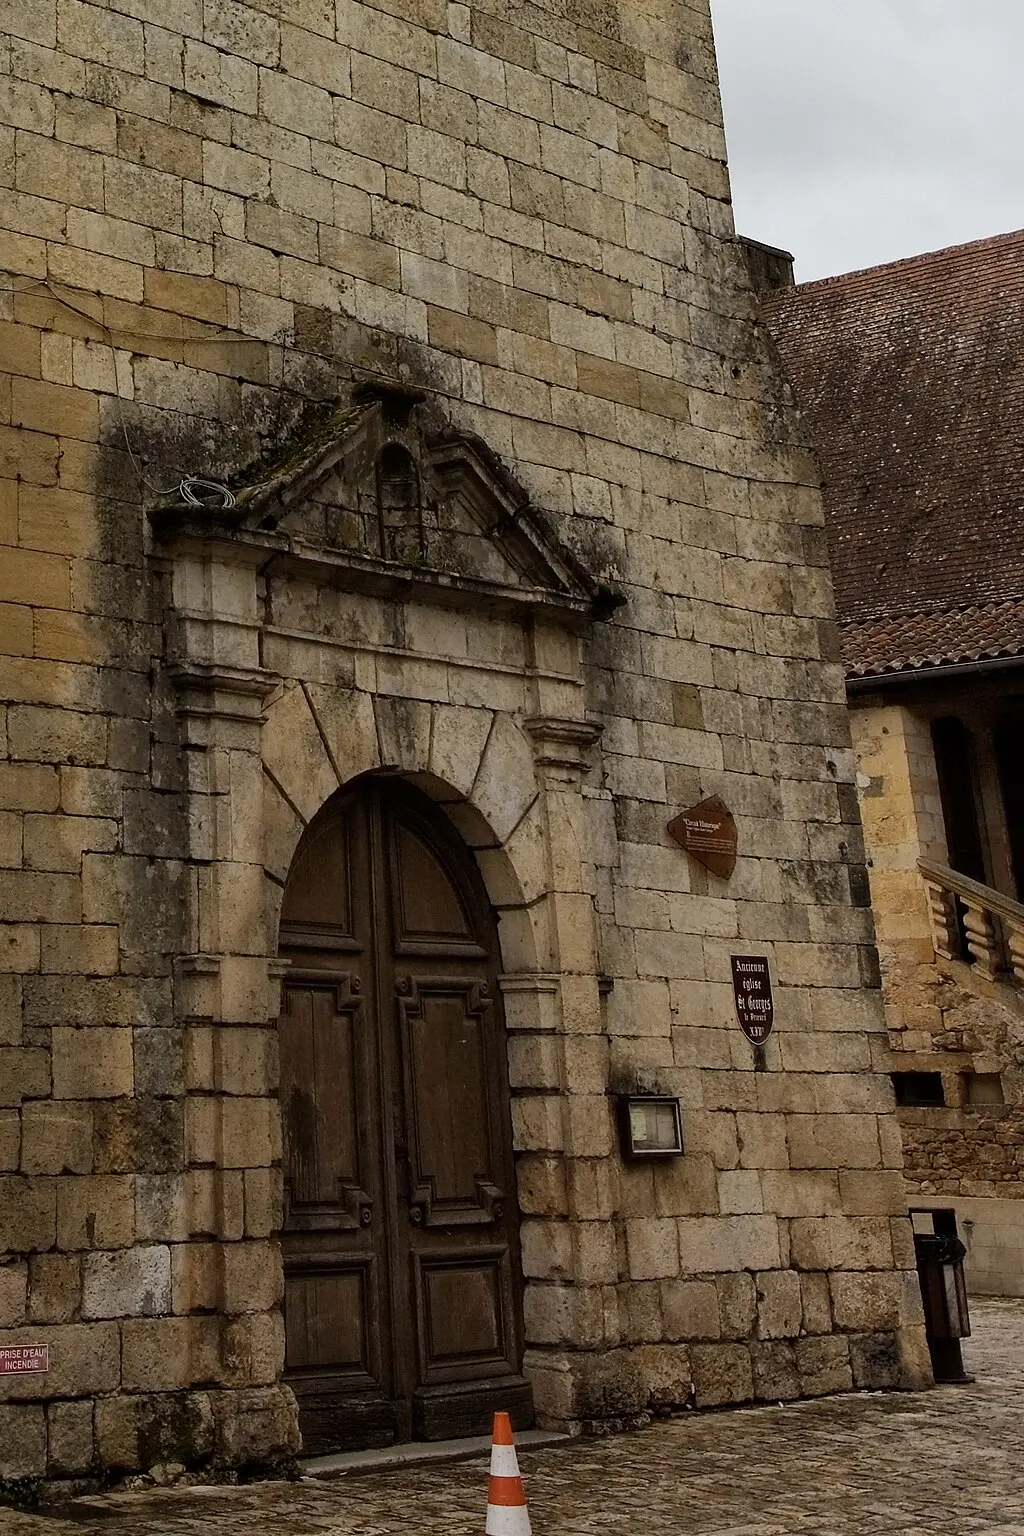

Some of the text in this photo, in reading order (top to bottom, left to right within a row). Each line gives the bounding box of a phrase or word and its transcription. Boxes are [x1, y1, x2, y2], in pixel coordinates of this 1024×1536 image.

[736, 960, 765, 973] Ancienne
[742, 977, 762, 991] église
[737, 994, 771, 1013] St Georges
[0, 1348, 44, 1359] PRISE D'EAU
[5, 1359, 39, 1370] INCENDIE
